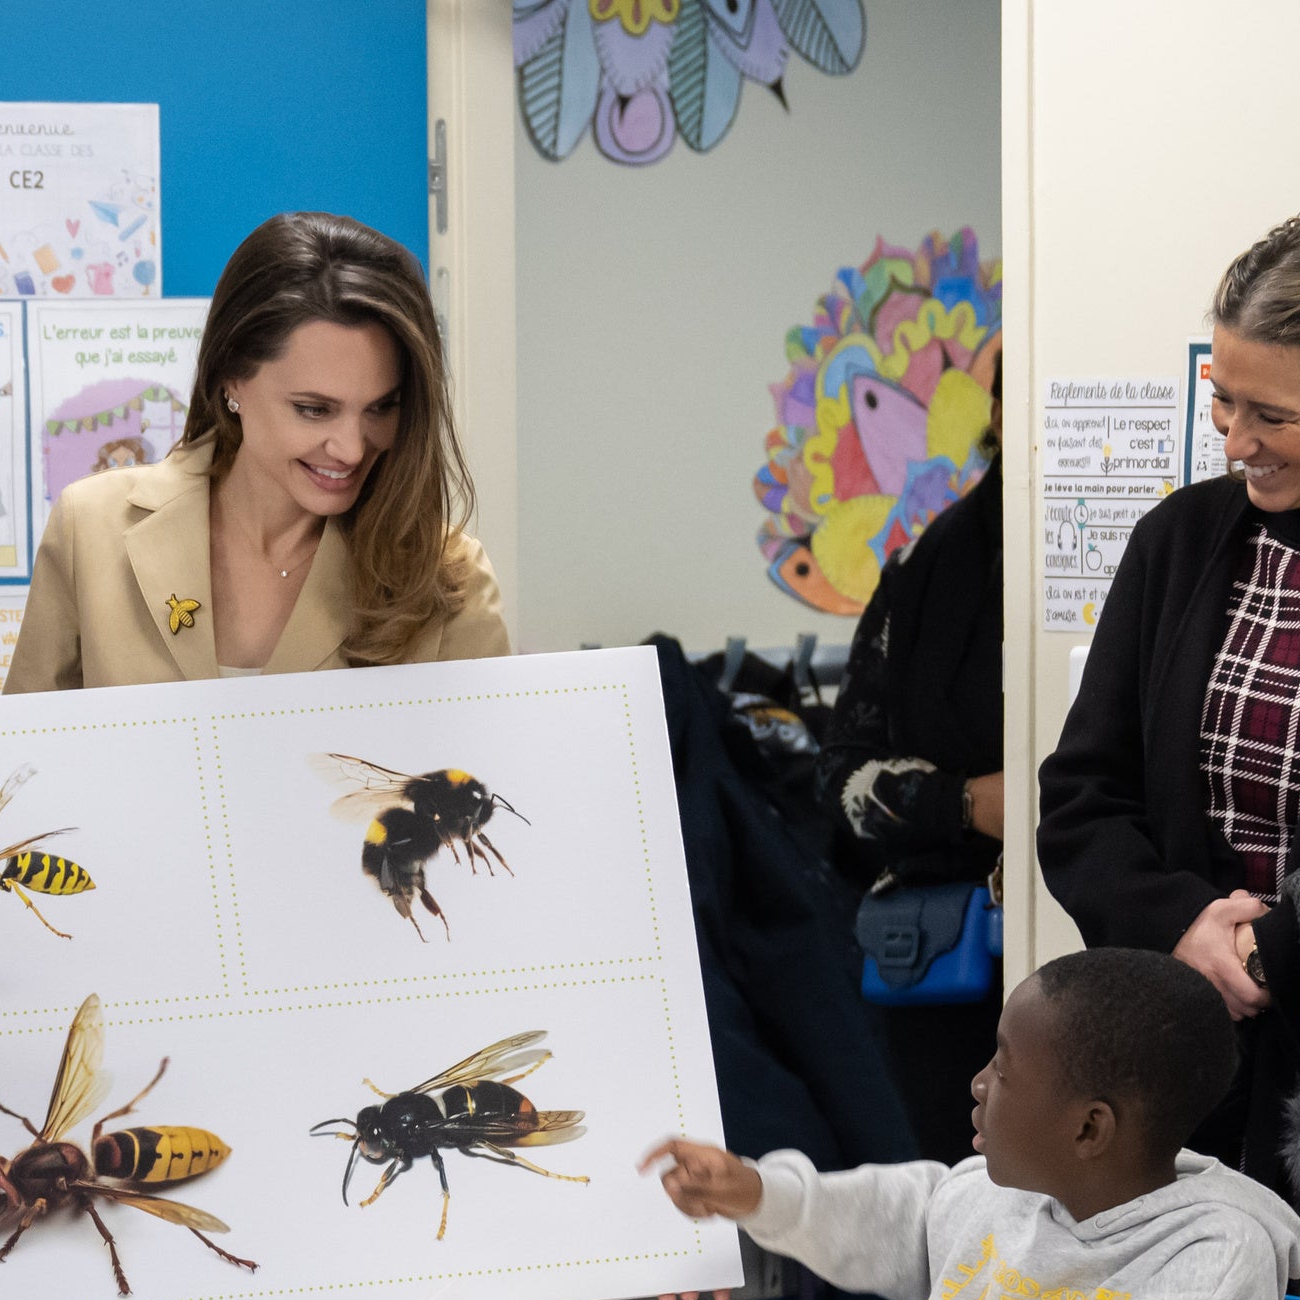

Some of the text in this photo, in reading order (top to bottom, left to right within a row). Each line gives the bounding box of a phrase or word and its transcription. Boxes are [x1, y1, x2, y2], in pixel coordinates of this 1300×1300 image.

[9, 170, 45, 189] CE2
[43, 323, 202, 342] L'erreur est la preuve
[75, 347, 177, 368] que j'ai essayé
[1110, 382, 1123, 400] de
[1126, 381, 1138, 400] la
[1141, 382, 1175, 400] classe
[1113, 418, 1171, 434] Le respect
[1129, 438, 1155, 450] c'est
[1044, 483, 1052, 493] Je
[1075, 484, 1083, 493] la
[1085, 484, 1104, 493] main
[1106, 485, 1125, 495] pour
